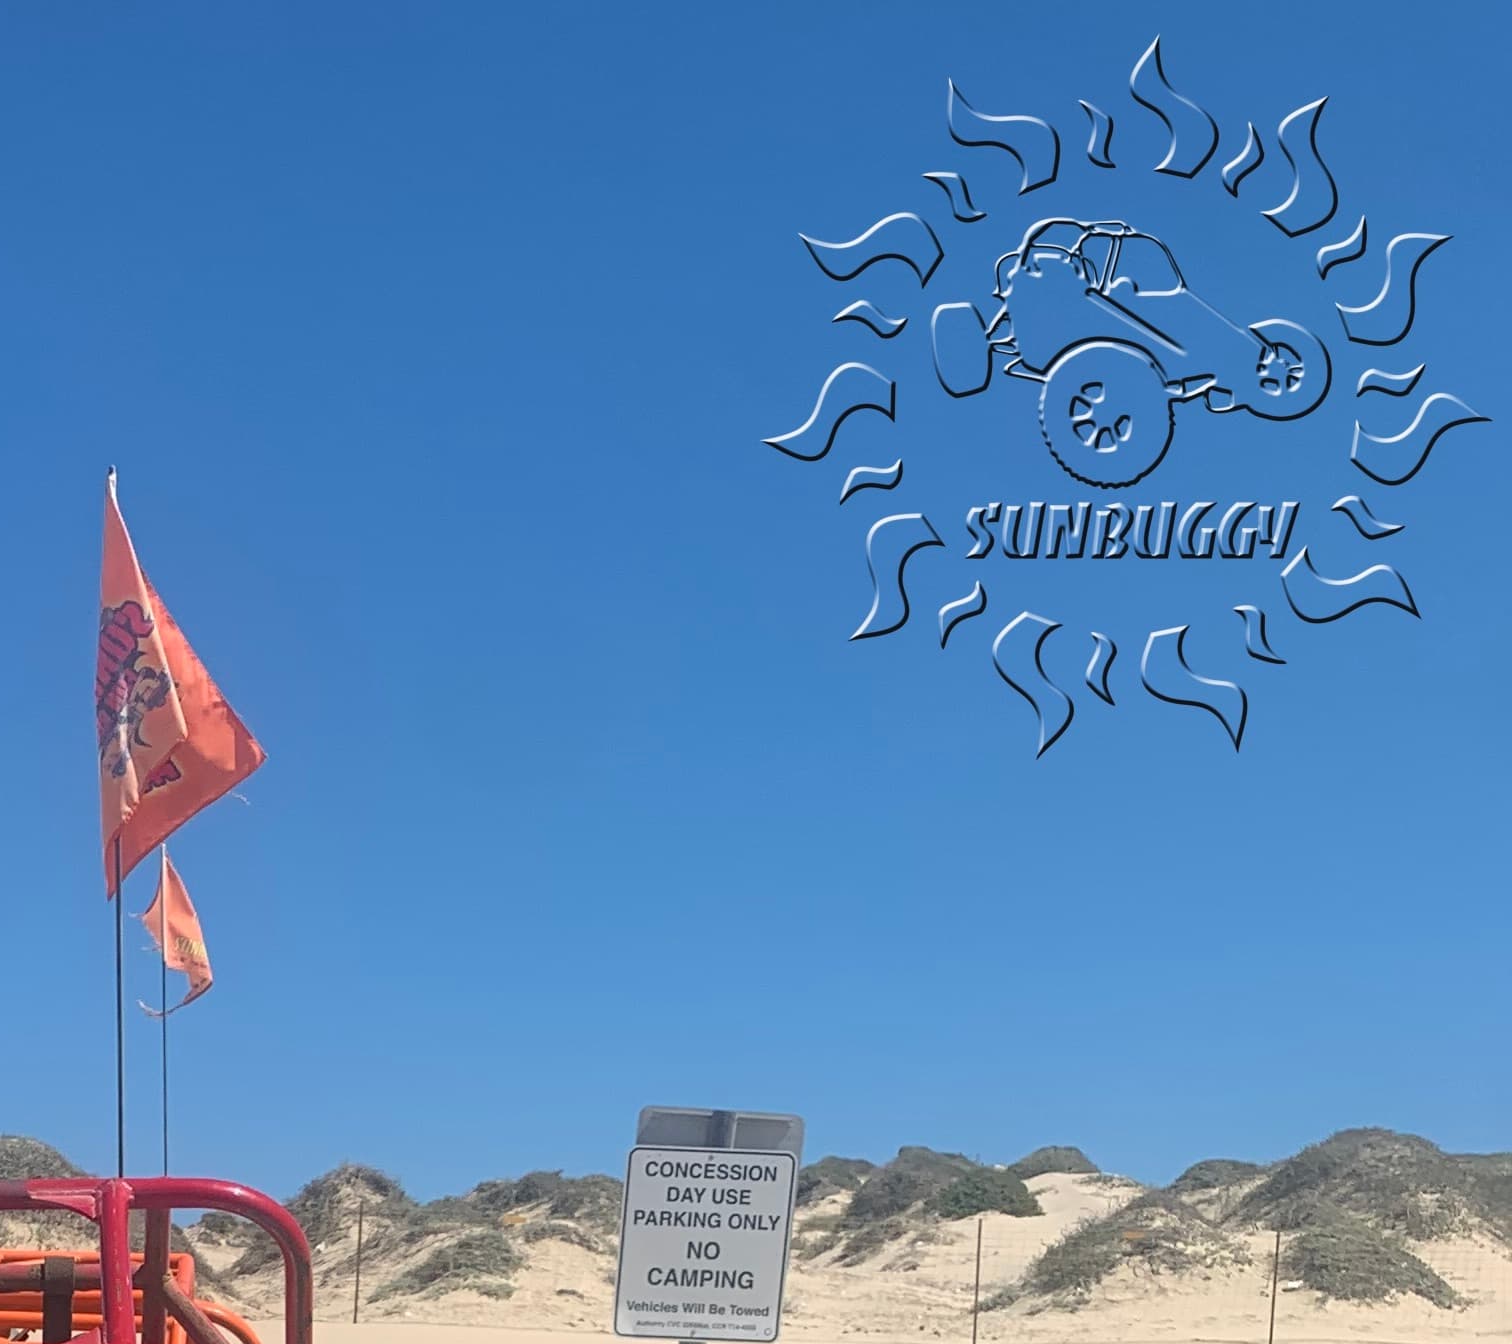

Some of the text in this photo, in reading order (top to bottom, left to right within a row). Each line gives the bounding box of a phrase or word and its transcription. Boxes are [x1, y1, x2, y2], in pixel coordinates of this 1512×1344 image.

[644, 1160, 778, 1182] CONCESSION
[666, 1186, 752, 1206] DAY USE
[633, 1209, 781, 1231] PARKING ONLY
[686, 1241, 721, 1260] NO
[647, 1267, 755, 1290] CAMPING
[626, 1300, 770, 1317] Vehicles Will Be Towed
